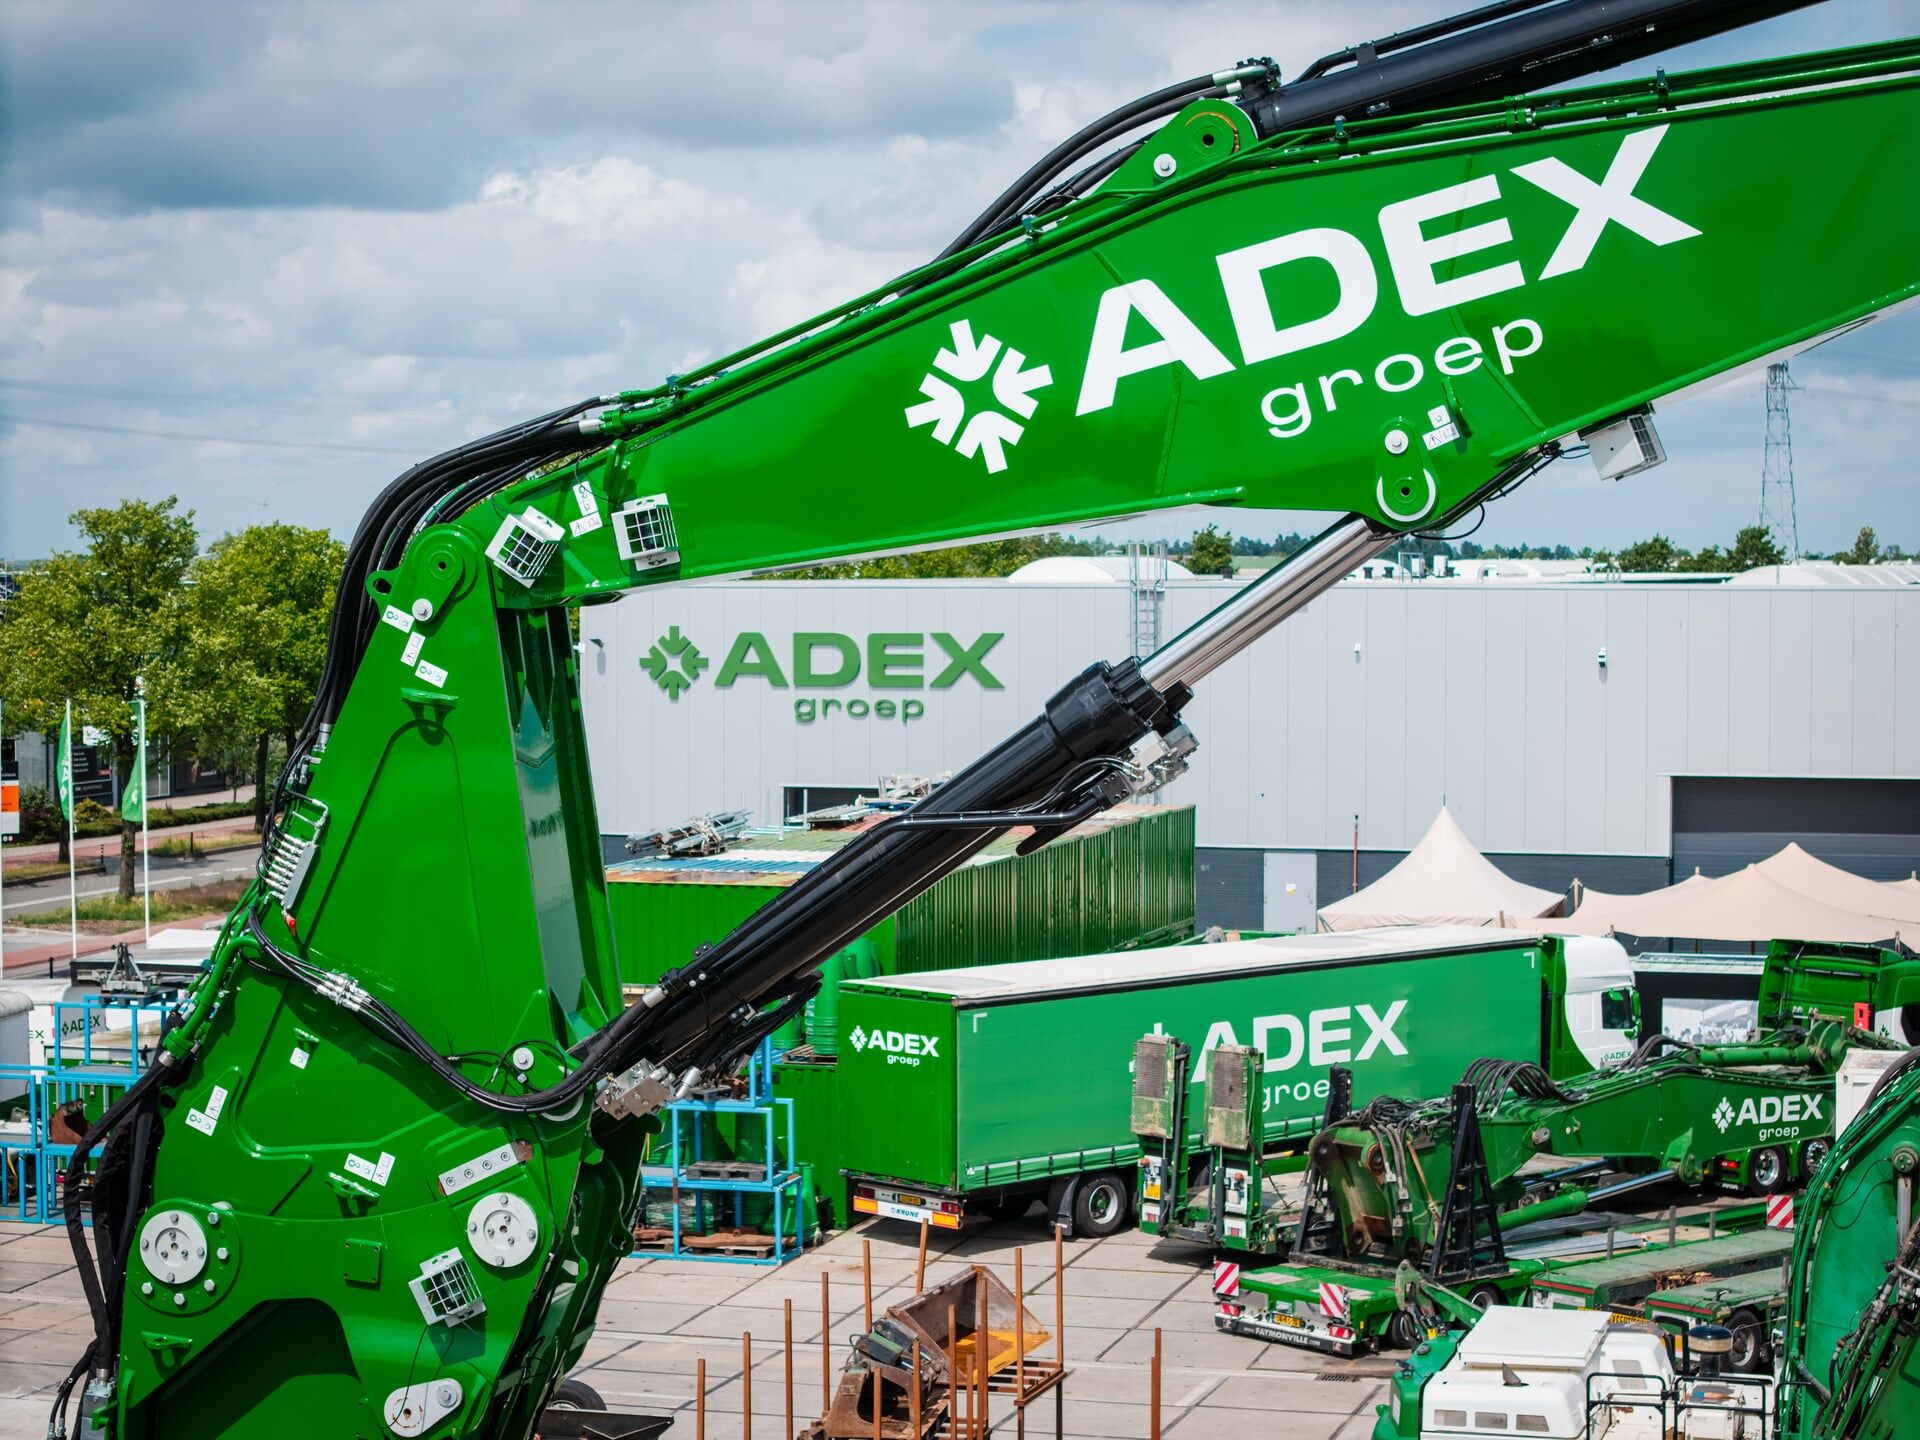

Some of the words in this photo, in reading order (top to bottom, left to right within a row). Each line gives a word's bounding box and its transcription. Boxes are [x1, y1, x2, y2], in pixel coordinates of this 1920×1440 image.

[1075, 123, 1703, 416] ADEX
[1260, 318, 1544, 439] groep
[714, 632, 1005, 689] ADEX
[794, 699, 924, 724] groep
[867, 1029, 940, 1057] ADEX
[1191, 1000, 1409, 1083] ADEX
[887, 1055, 920, 1067] groep
[1262, 1079, 1330, 1112] groe
[1735, 1093, 1824, 1126] ADEX
[1759, 1126, 1800, 1141] groep
[896, 1208, 919, 1218] KRONE
